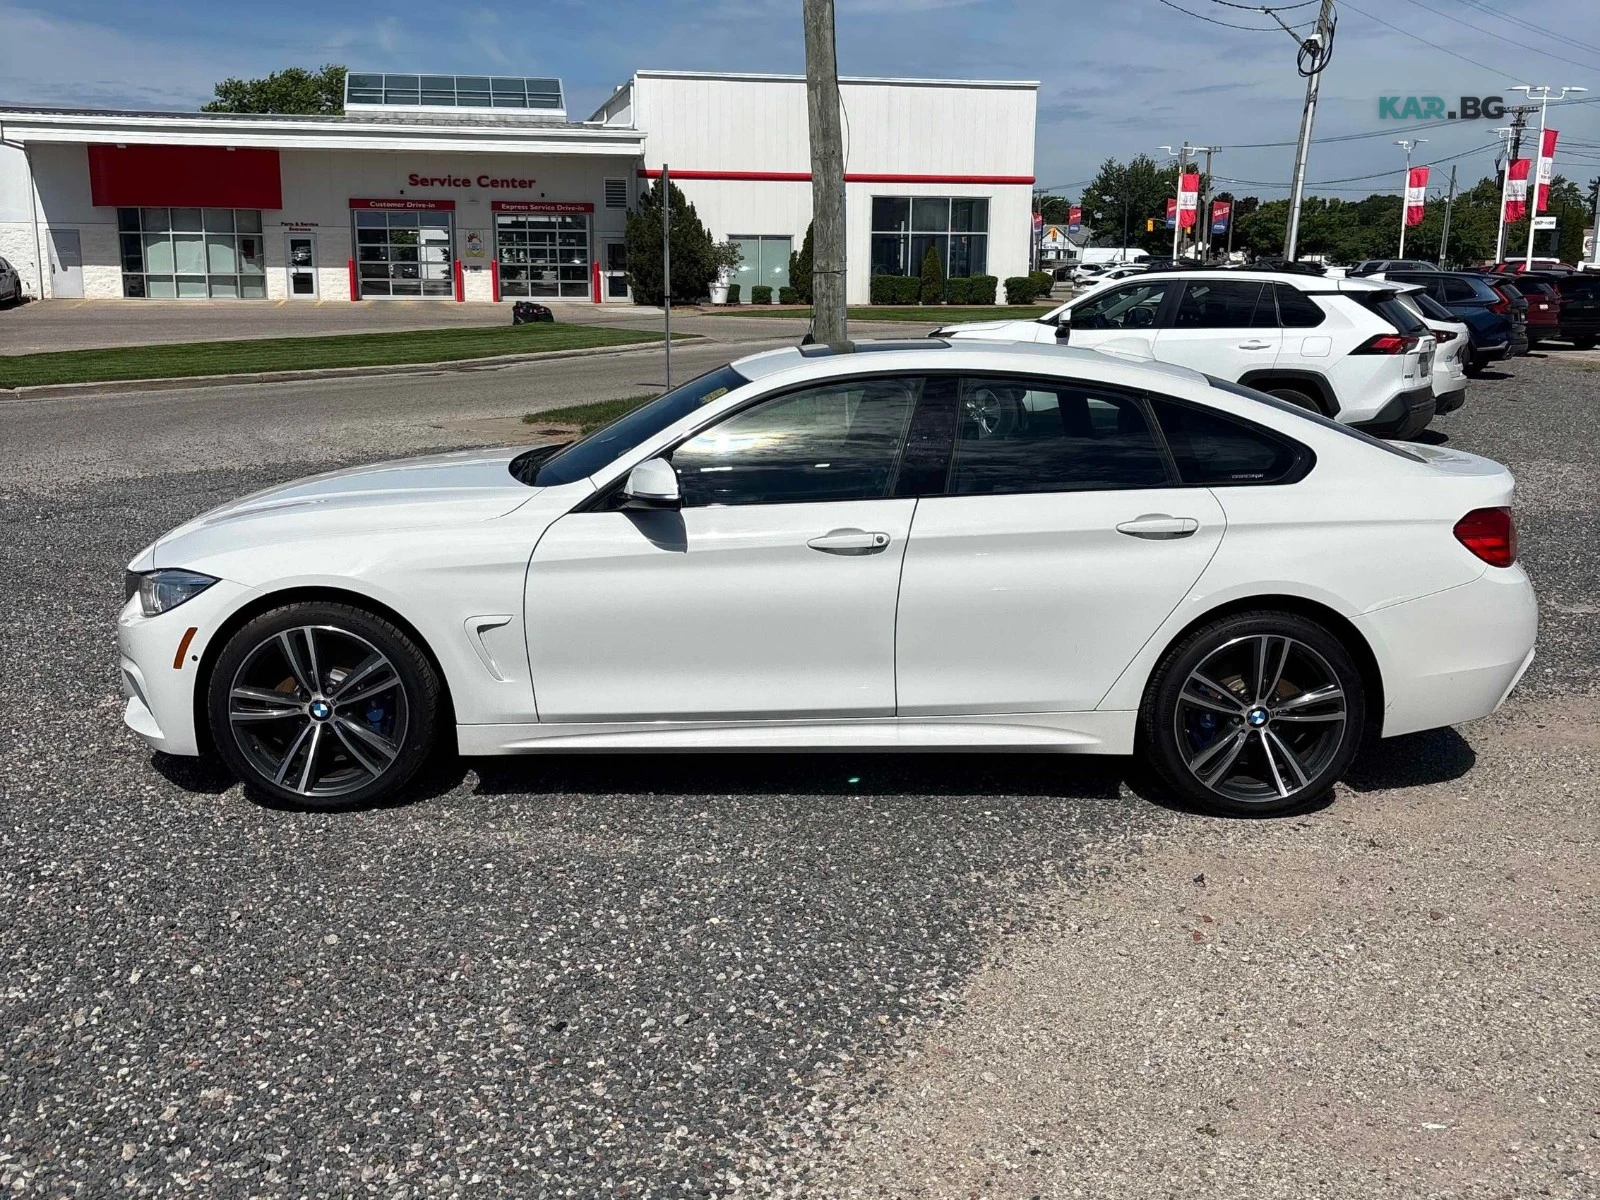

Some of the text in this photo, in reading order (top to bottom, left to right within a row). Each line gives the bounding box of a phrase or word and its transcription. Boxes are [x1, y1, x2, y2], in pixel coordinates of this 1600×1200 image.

[408, 173, 536, 189] Service Center
[501, 203, 528, 211] Express
